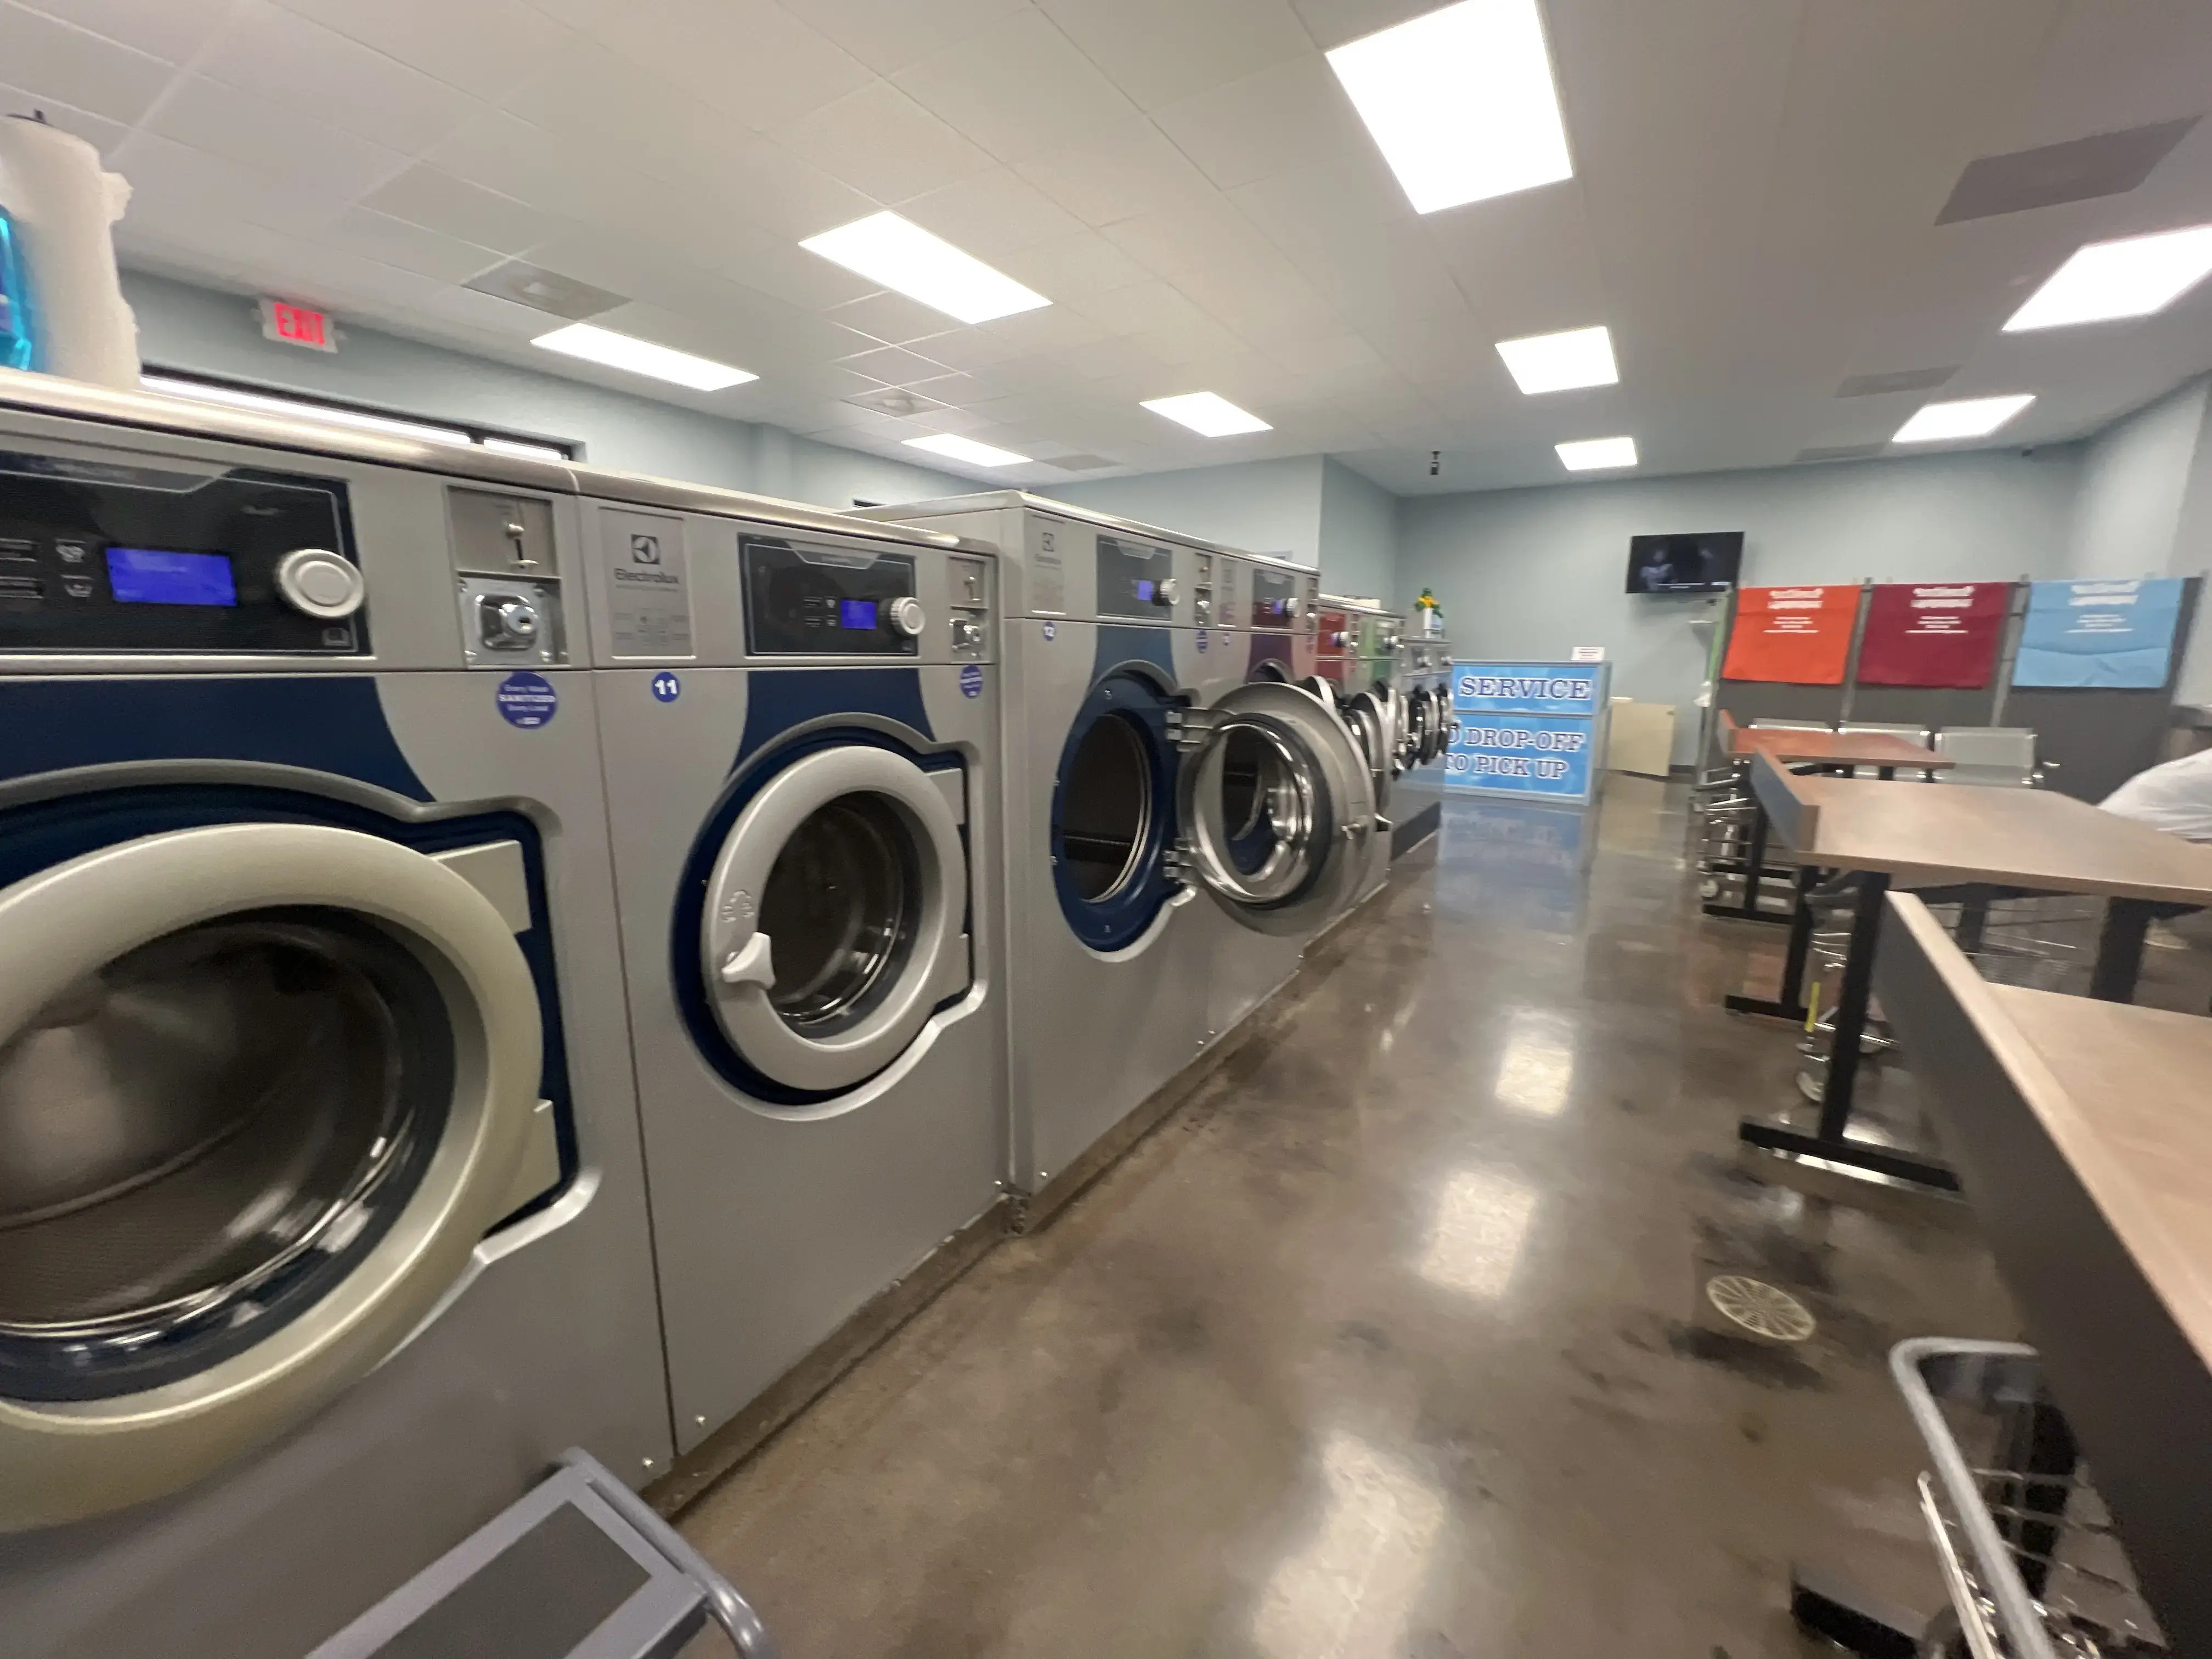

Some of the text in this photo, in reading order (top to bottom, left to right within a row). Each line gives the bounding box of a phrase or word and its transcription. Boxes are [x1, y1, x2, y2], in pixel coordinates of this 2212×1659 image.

[273, 301, 325, 346] EXIT
[654, 679, 678, 695] 11
[1461, 676, 1591, 699] SERVICE
[1465, 728, 1584, 751] DROP-OFF
[1474, 757, 1530, 776] PICK
[1537, 760, 1568, 778] UP
